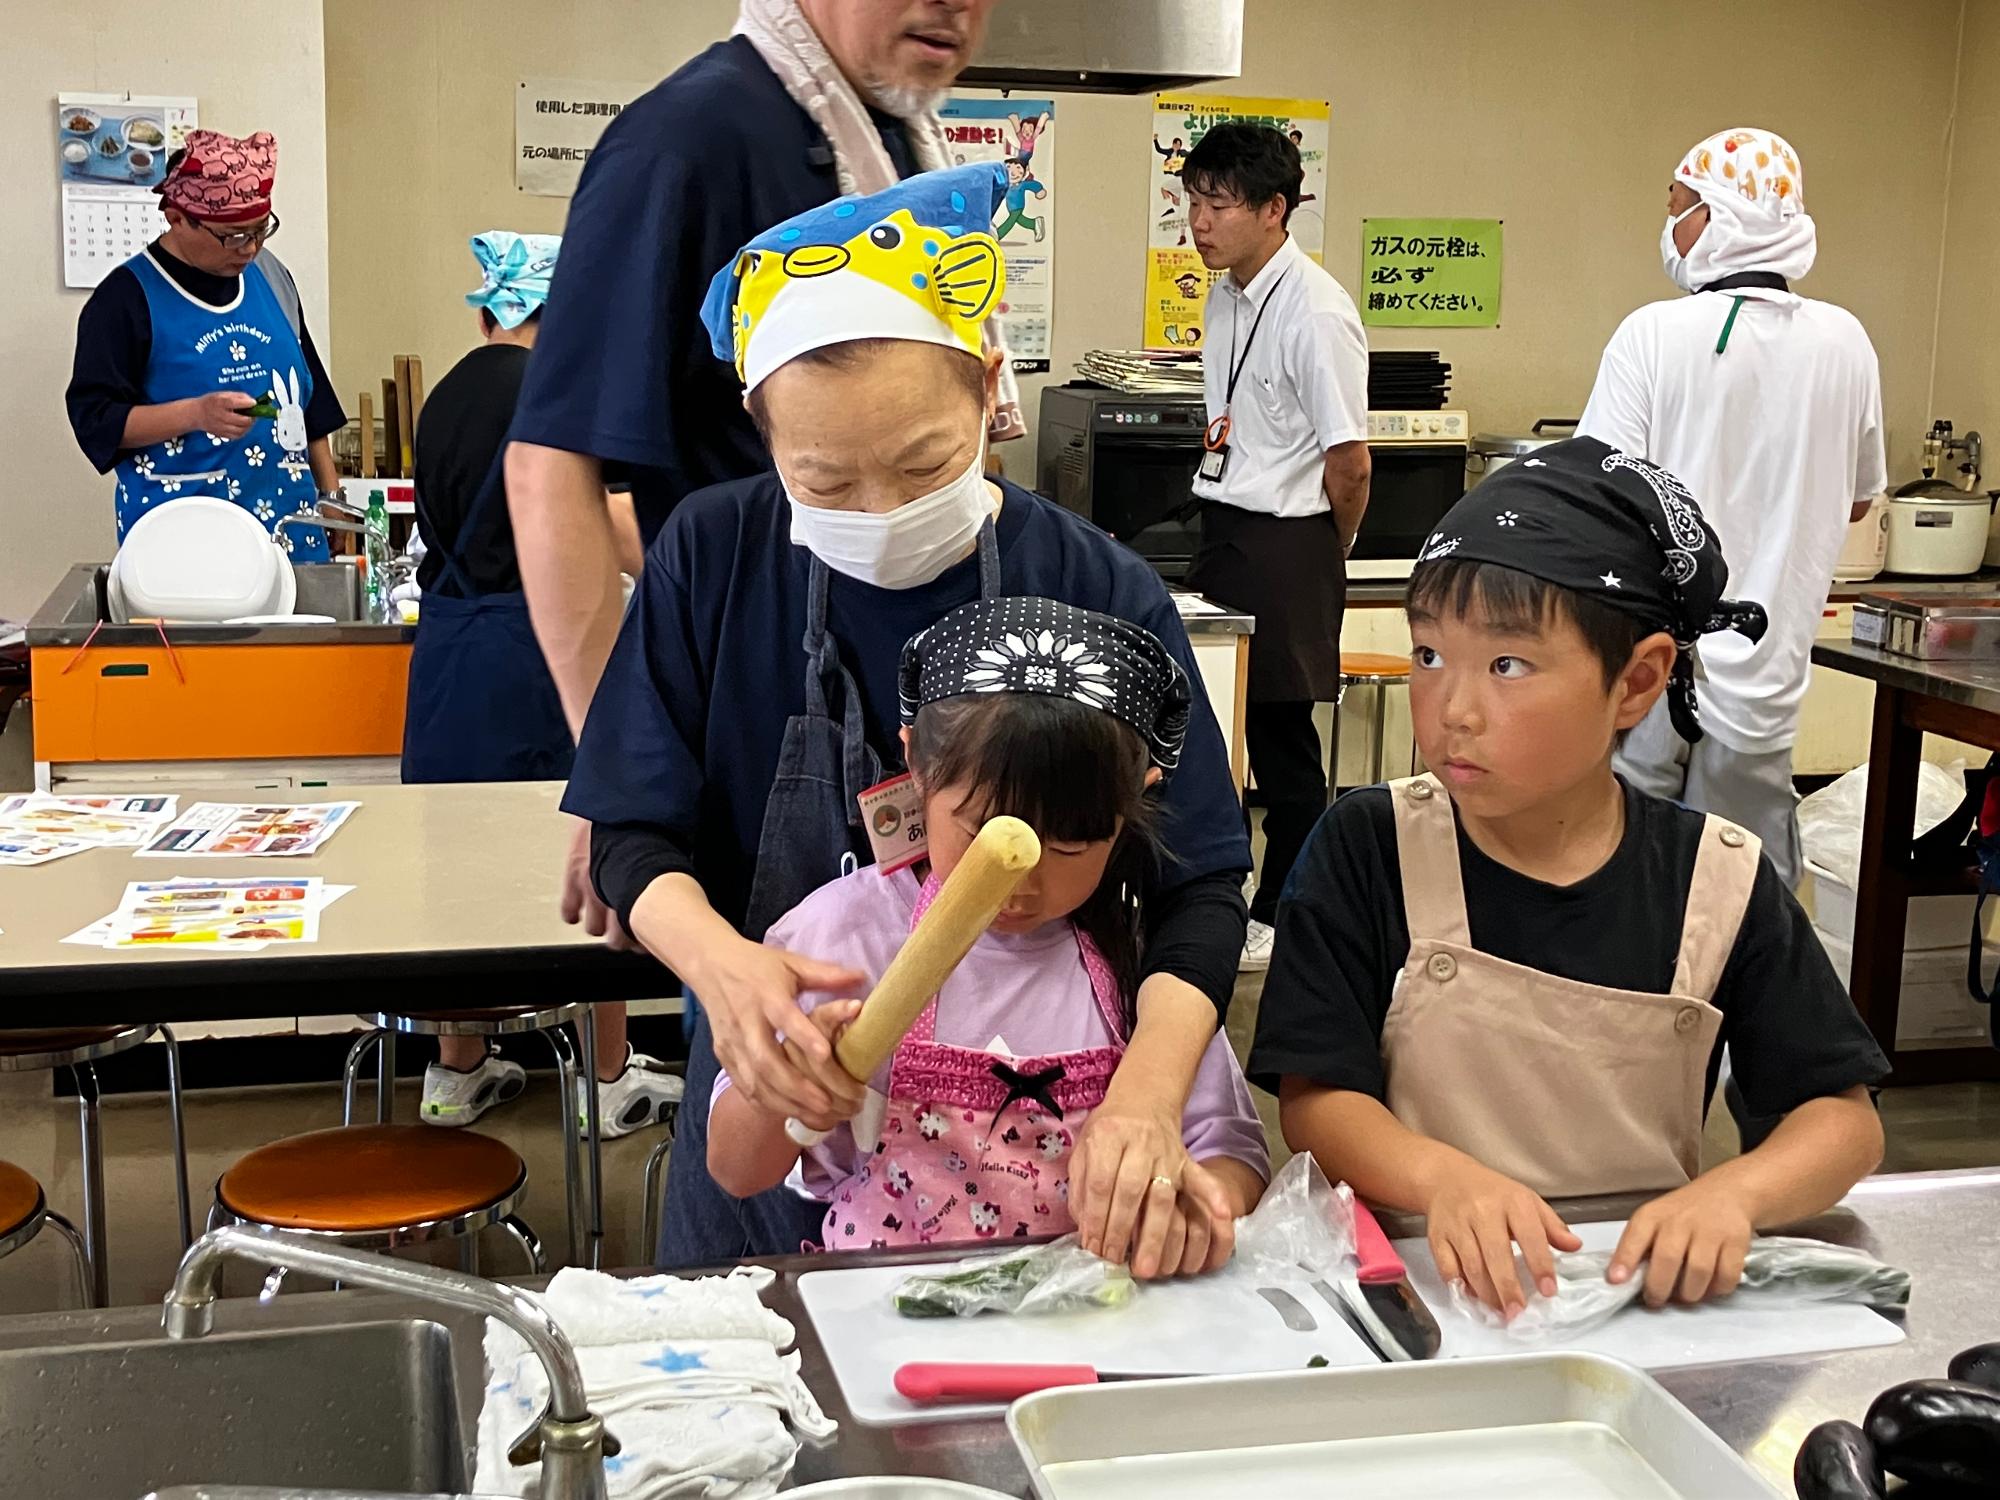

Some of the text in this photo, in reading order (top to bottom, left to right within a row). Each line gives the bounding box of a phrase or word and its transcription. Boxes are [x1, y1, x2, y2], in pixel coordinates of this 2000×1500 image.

[535, 100, 629, 116] 使用した調理用
[1370, 236, 1487, 258] ガスの元栓は、
[1370, 266, 1434, 284] 必ず
[1367, 292, 1484, 312] 締めてください。
[194, 322, 272, 354] Miffy's birthday!
[250, 362, 262, 370] on
[980, 1162, 1029, 1180] Hello Kitty
